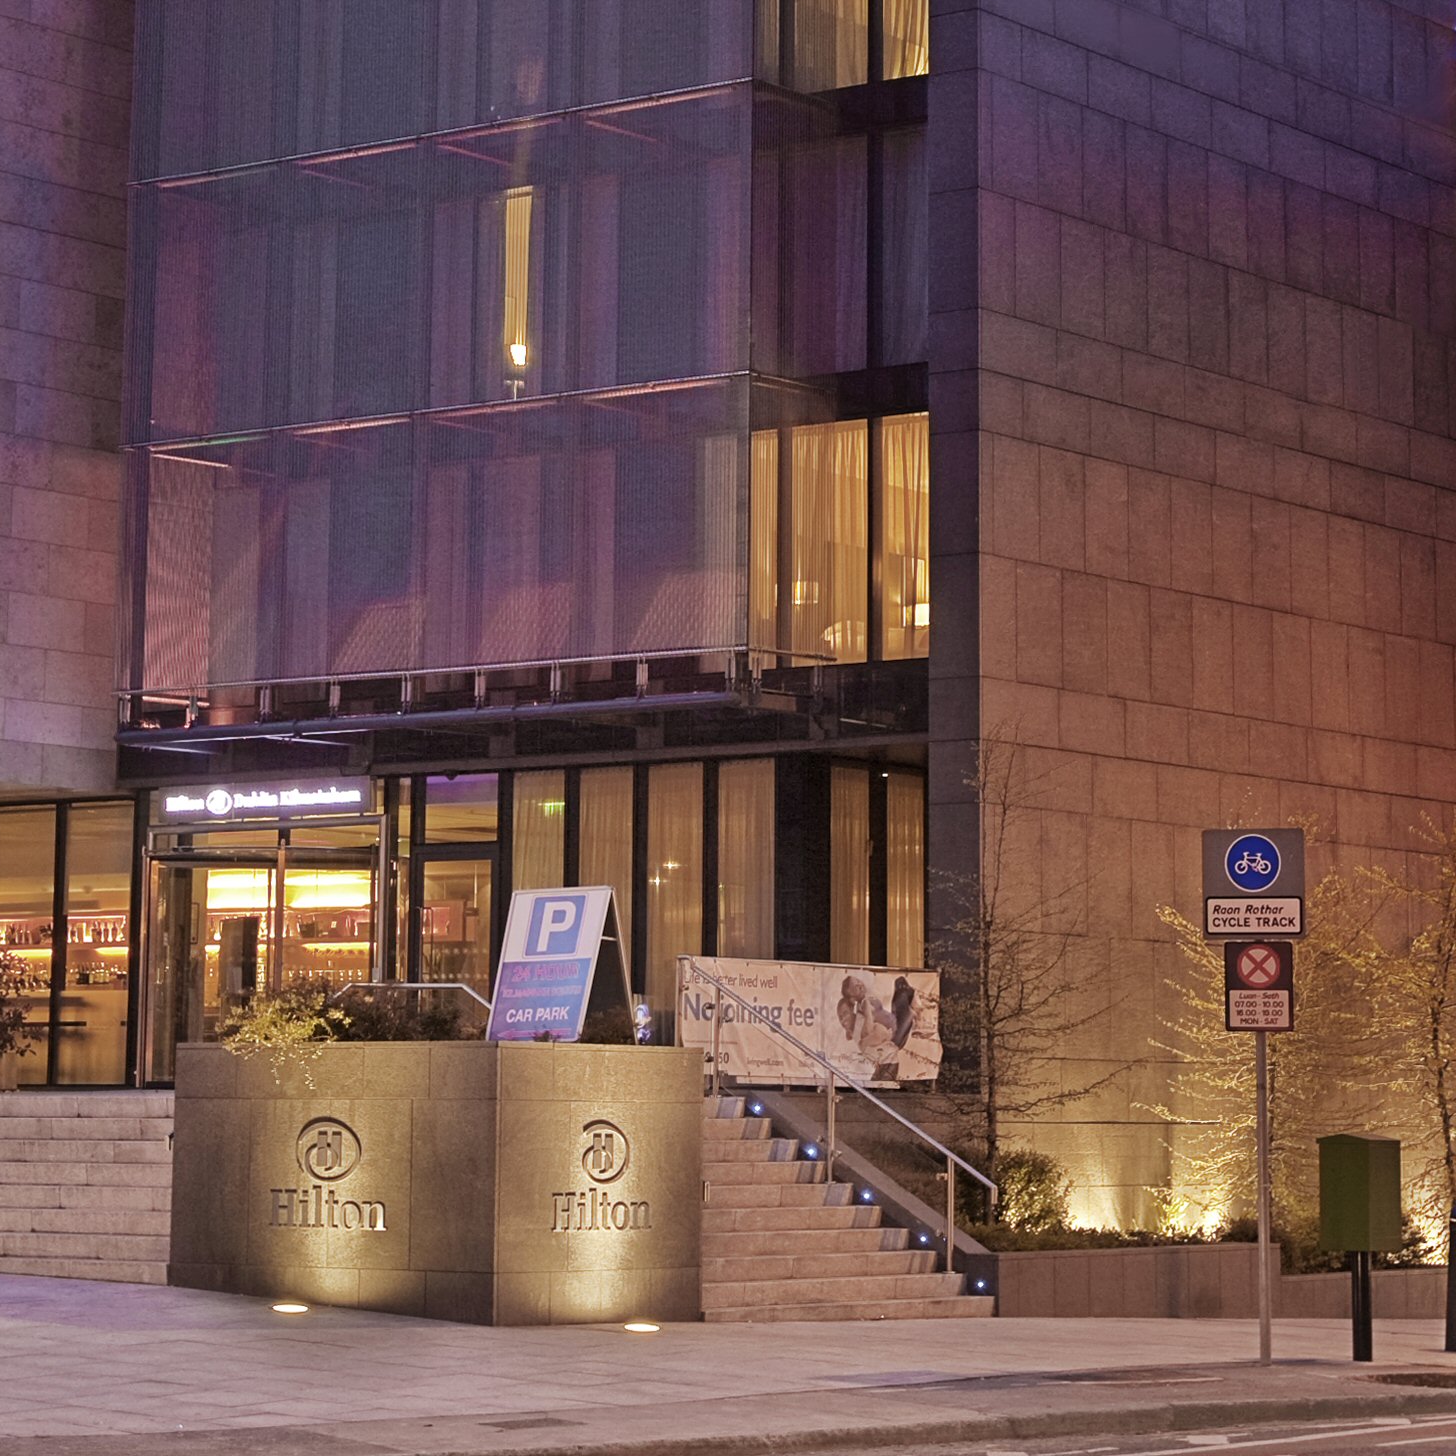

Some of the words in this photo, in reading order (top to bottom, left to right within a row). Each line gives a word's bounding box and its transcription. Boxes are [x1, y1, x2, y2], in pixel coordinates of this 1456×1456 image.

[1212, 904, 1241, 915] Raon
[1244, 904, 1284, 915] Rothar
[536, 901, 577, 952] P
[1212, 917, 1251, 928] CYCLE
[1255, 917, 1296, 928] TRACK
[739, 974, 758, 988] lived
[760, 976, 779, 989] well
[506, 1008, 533, 1023] CAR
[535, 1006, 571, 1022] PARK
[1239, 1017, 1259, 1025] MON
[1264, 1017, 1280, 1025] SAT
[269, 1184, 388, 1233] Hilton
[551, 1187, 653, 1234] Hilton
